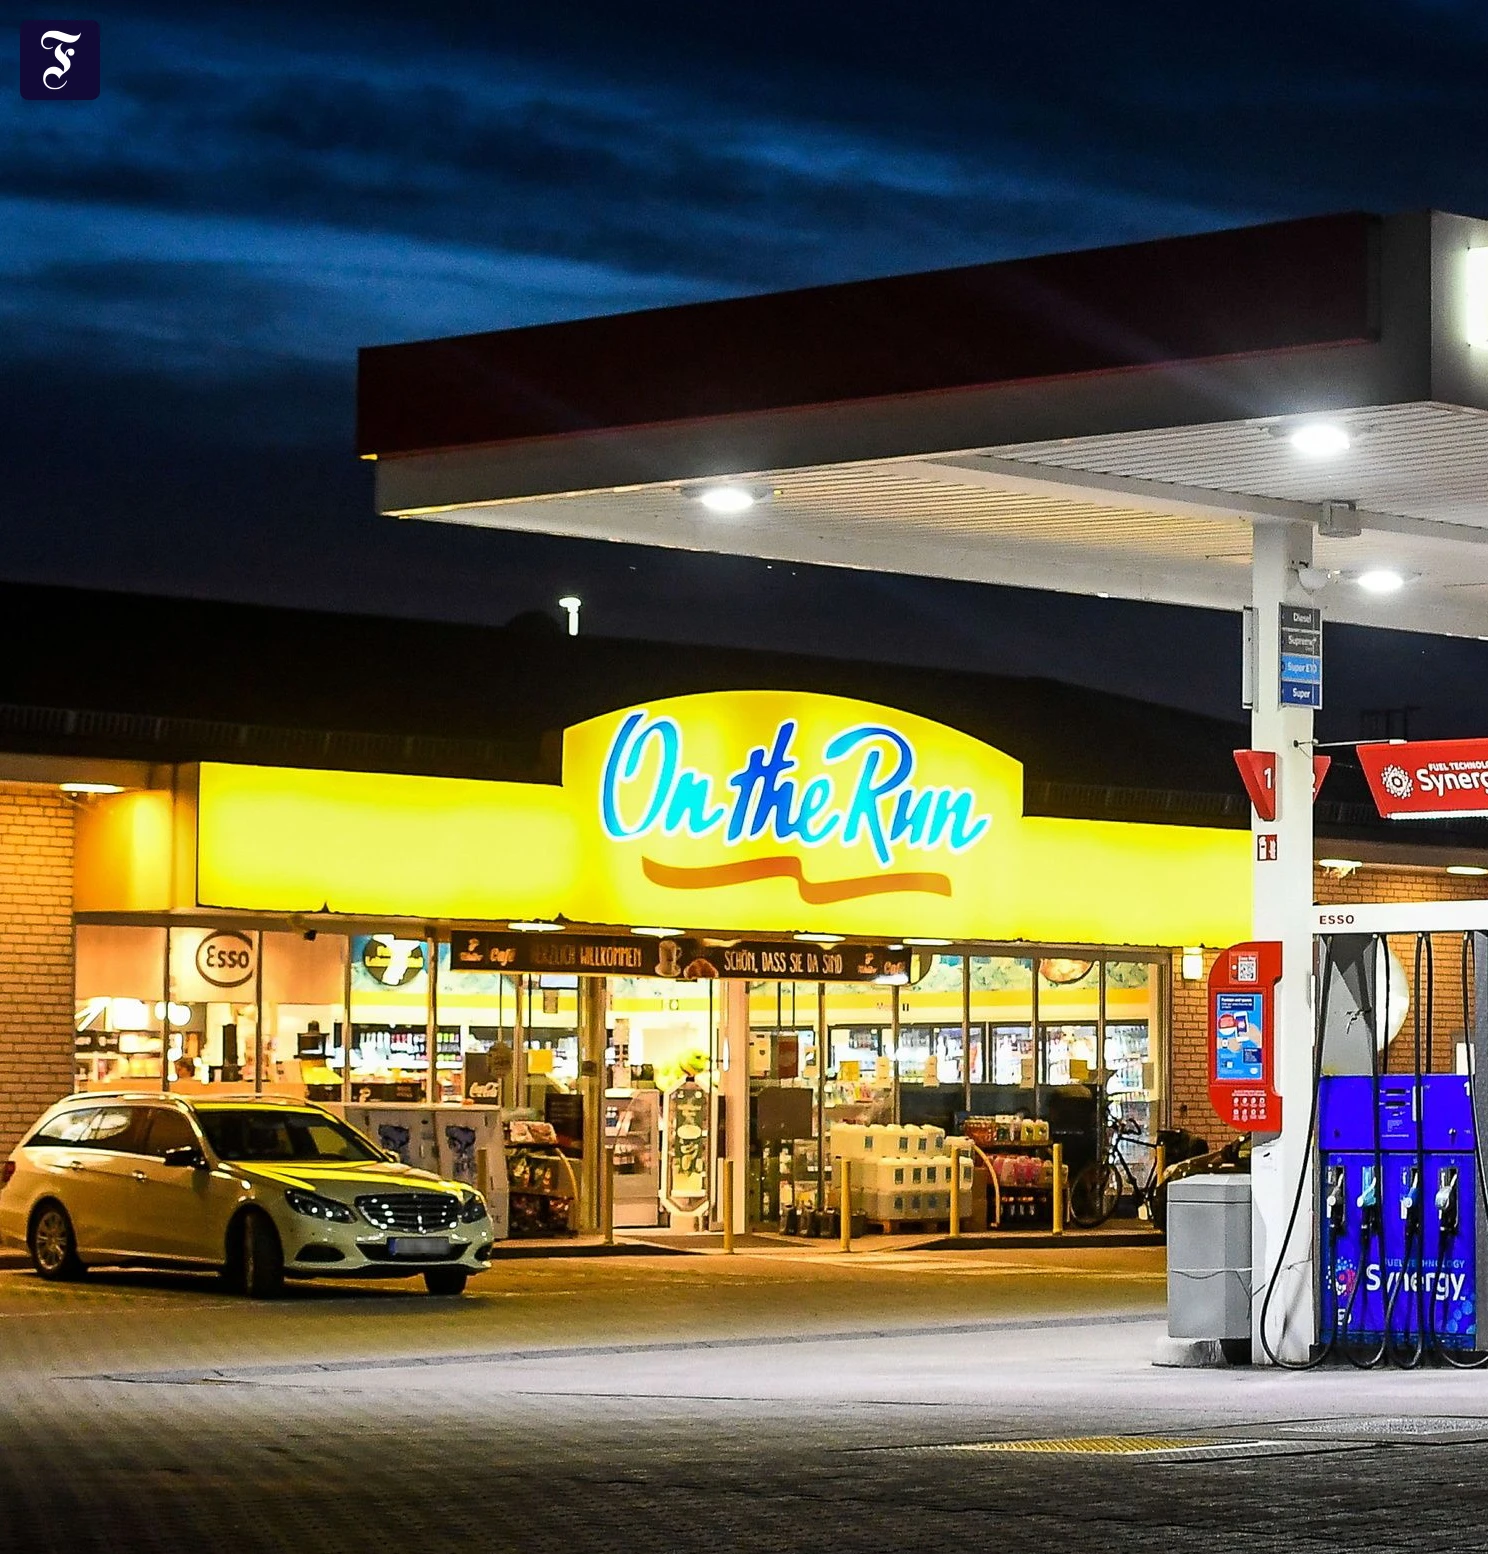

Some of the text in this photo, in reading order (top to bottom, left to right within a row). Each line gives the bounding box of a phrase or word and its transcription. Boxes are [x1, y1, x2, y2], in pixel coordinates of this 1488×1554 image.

[1288, 662, 1306, 674] Super
[1293, 688, 1311, 699] Super
[1428, 762, 1449, 772] FUEL
[600, 711, 989, 865] On the Run
[1264, 768, 1272, 789] 1
[1319, 914, 1354, 925] ESSO
[206, 945, 249, 968] Esso
[580, 946, 642, 968] WILLKOMMEN
[761, 951, 787, 973] DASS
[790, 952, 804, 973] SIE
[807, 953, 819, 973] DA
[822, 954, 843, 974] SIND
